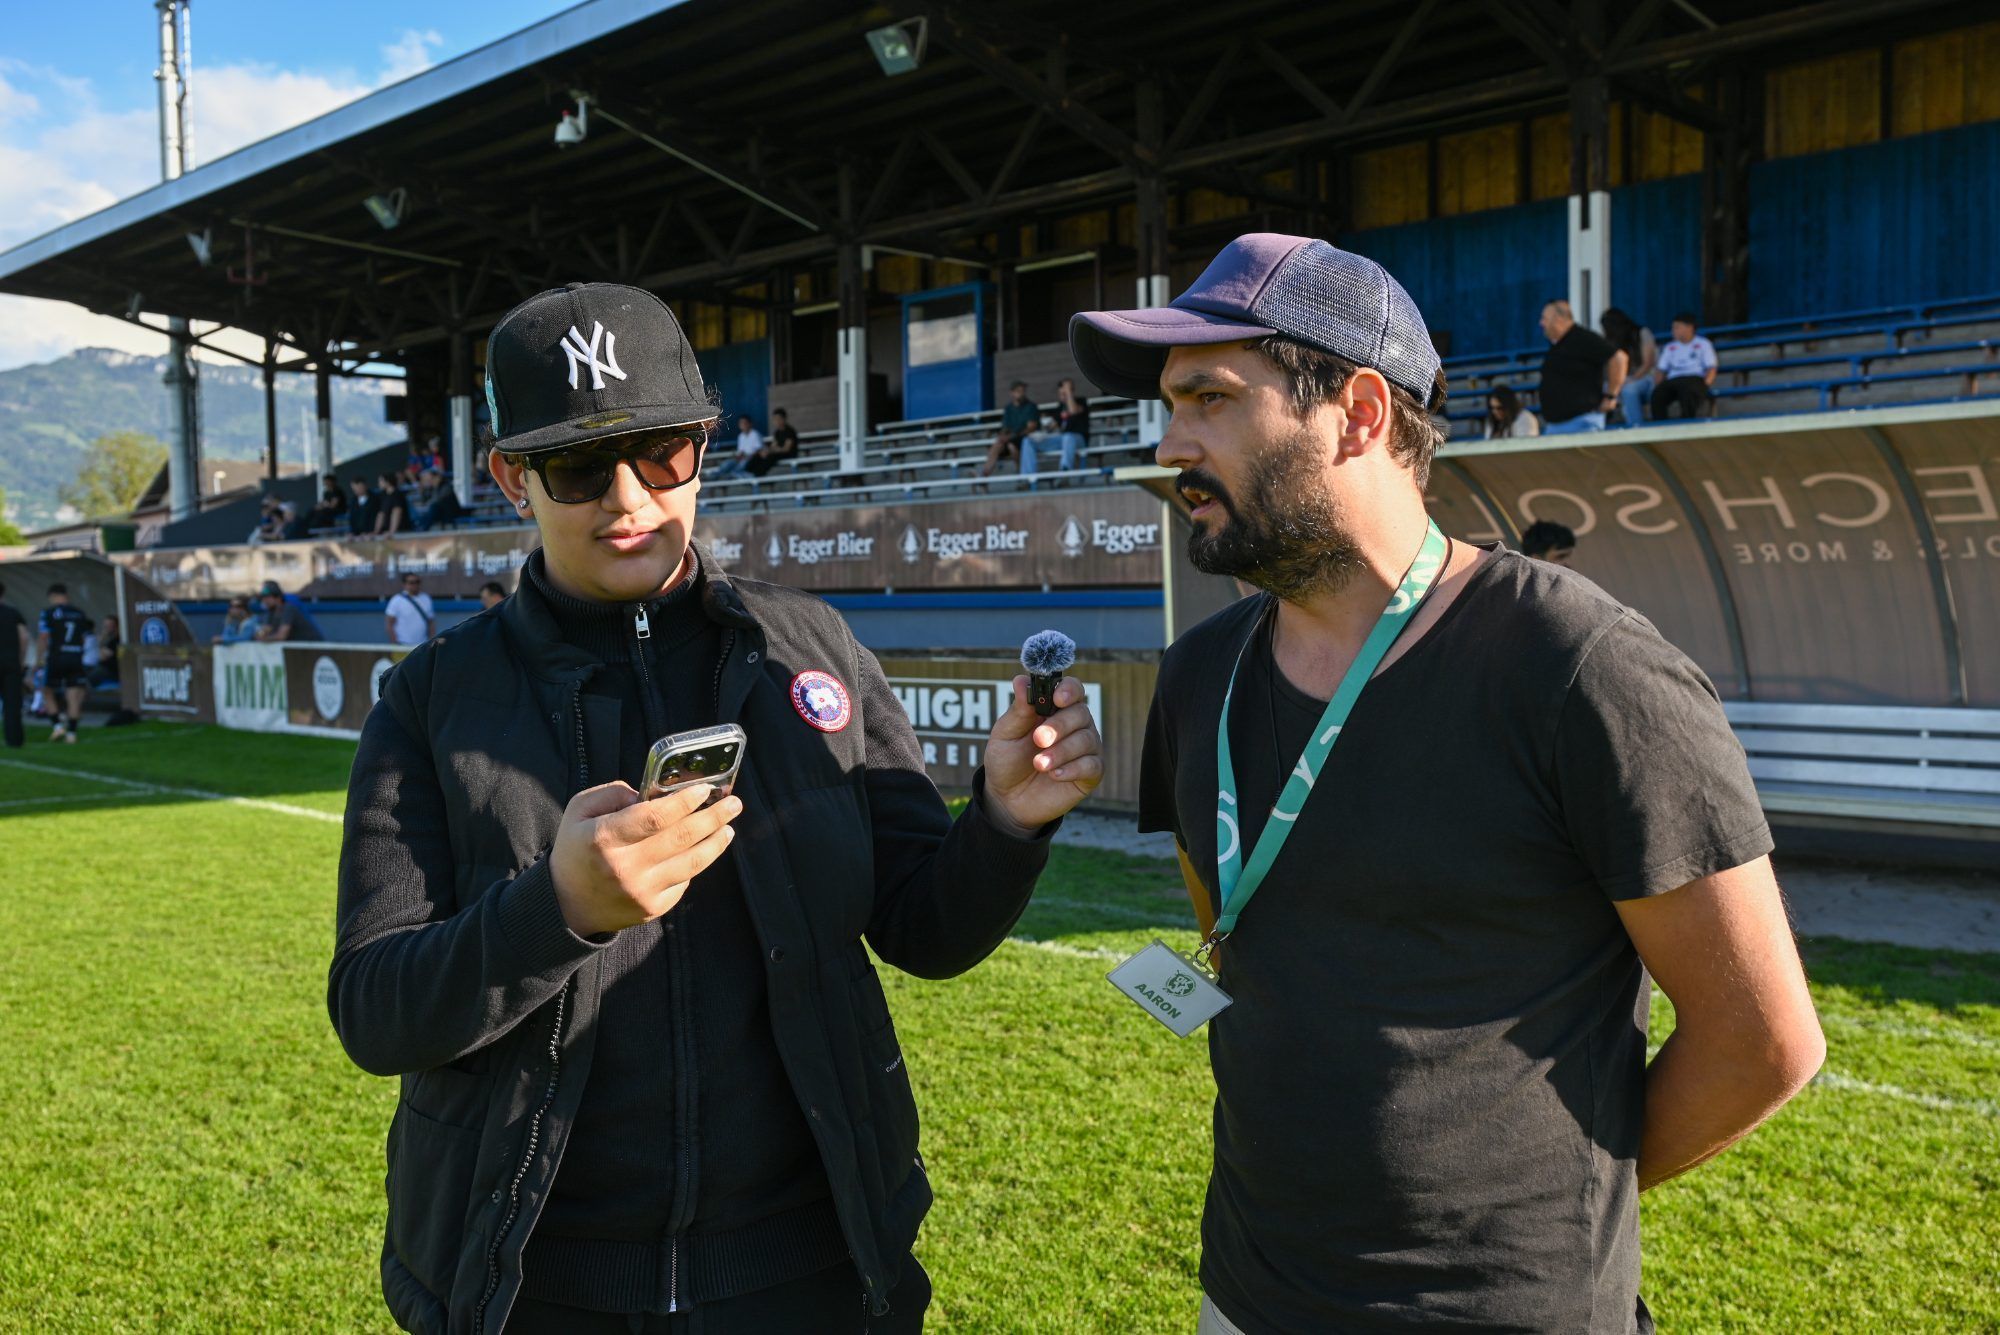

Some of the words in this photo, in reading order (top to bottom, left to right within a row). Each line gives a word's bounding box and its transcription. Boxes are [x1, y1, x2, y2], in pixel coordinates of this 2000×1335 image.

[560, 320, 627, 390] NY
[710, 537, 743, 559] Bier
[788, 534, 835, 564] Egger
[836, 531, 874, 556] Bier
[927, 528, 983, 560] Egger
[985, 523, 1028, 550] Bier
[1091, 519, 1158, 553] Egger
[134, 601, 171, 614] HEIM
[64, 621, 76, 643] 7
[225, 664, 286, 711] IMM
[891, 686, 992, 730] HIGH
[1134, 983, 1182, 1019] AARON
